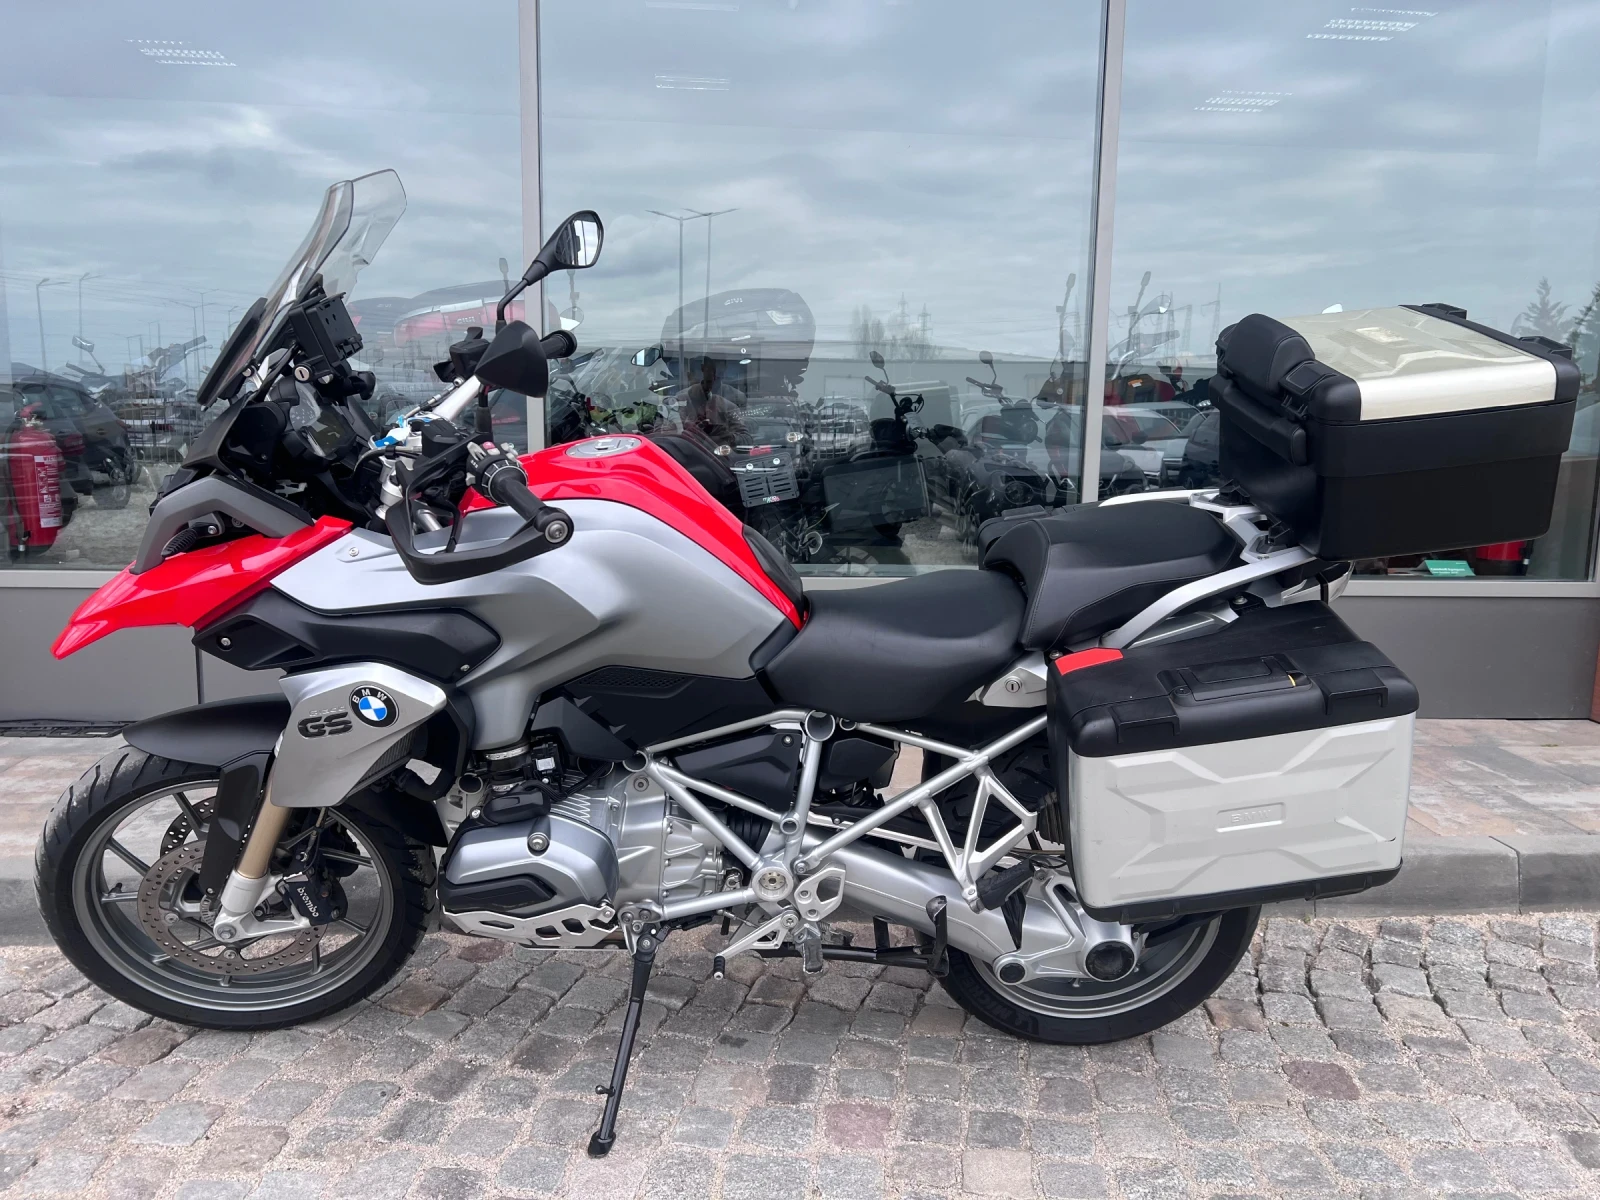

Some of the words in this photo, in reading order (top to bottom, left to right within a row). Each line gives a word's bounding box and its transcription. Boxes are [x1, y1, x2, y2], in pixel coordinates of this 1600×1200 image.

[352, 688, 387, 704] BMW
[298, 712, 353, 738] GS
[1231, 809, 1271, 823] BMW
[296, 886, 319, 917] brembo
